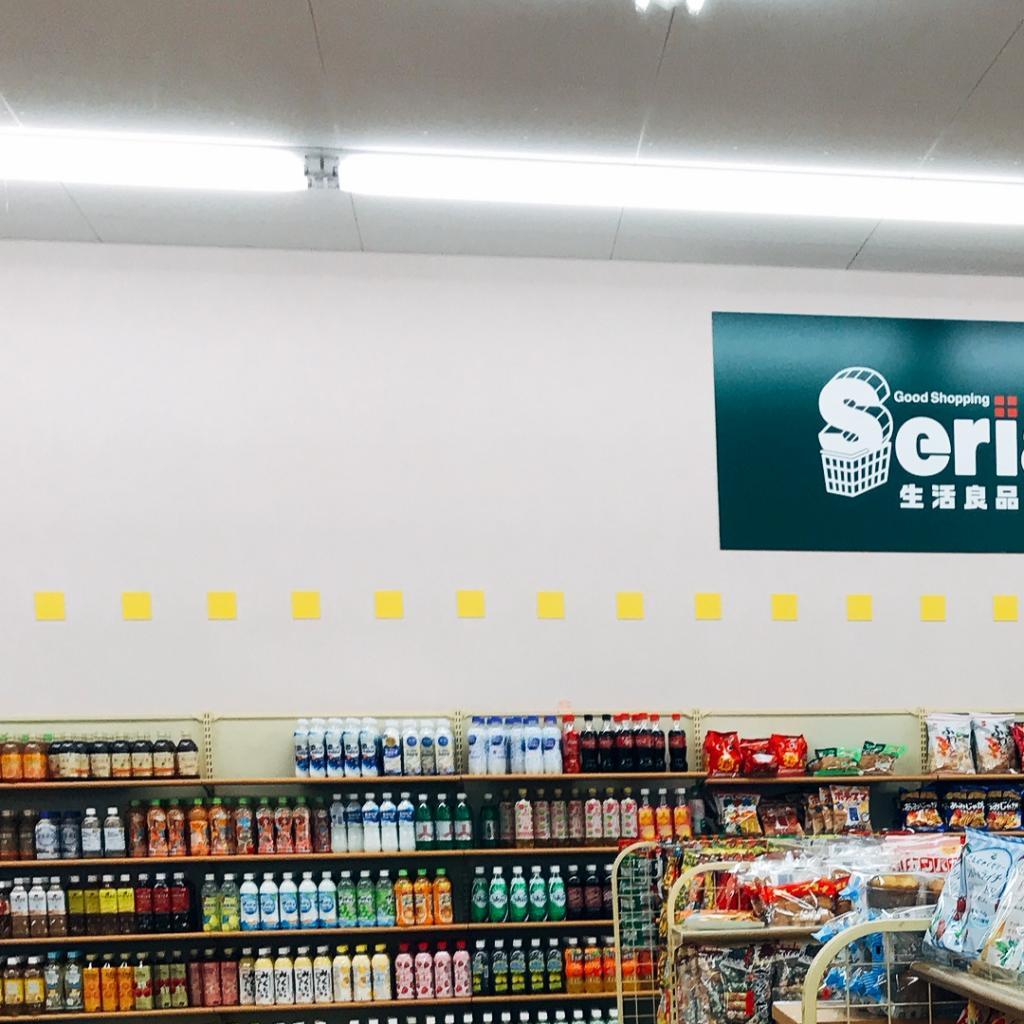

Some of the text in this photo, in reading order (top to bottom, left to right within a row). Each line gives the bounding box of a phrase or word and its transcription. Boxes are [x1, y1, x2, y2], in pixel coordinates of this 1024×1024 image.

[893, 390, 990, 407] Good Shopping
[899, 483, 1020, 511] 生活良品
